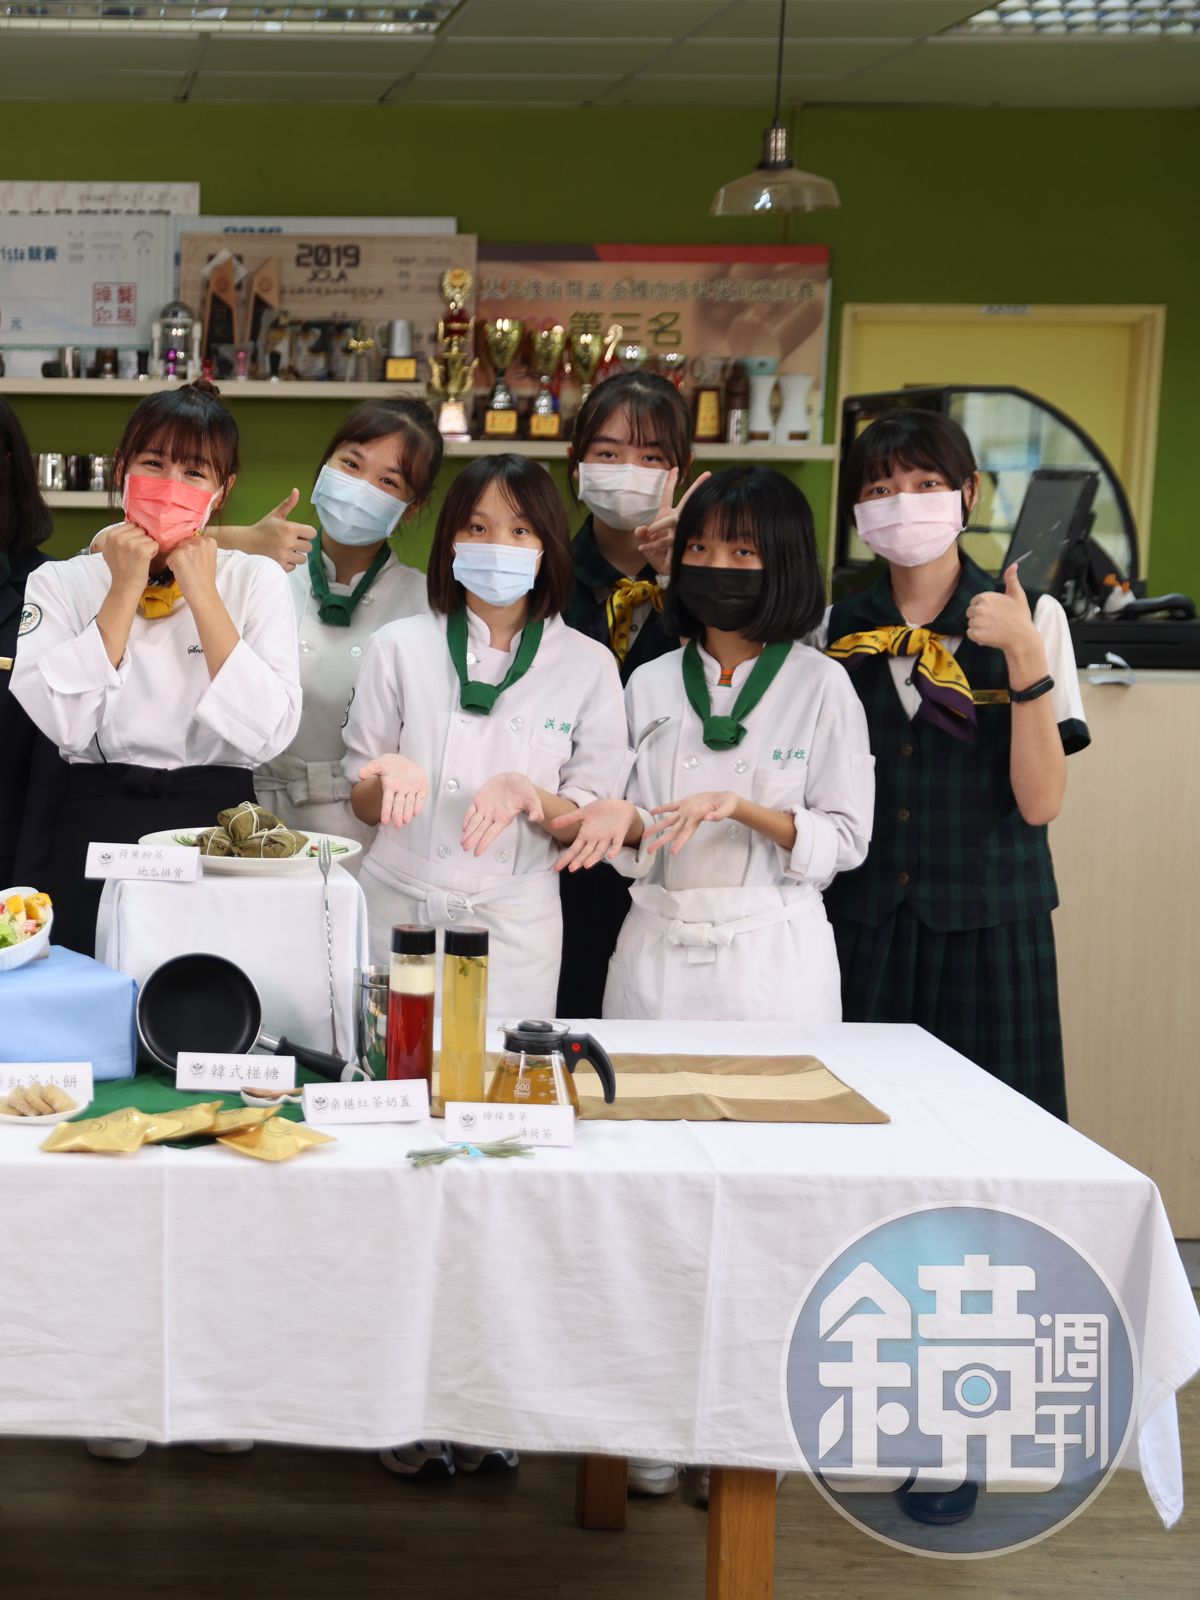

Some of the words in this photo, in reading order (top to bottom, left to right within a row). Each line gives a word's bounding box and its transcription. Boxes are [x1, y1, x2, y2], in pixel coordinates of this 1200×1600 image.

[295, 243, 361, 268] 2019
[9, 316, 23, 331] 元
[567, 309, 684, 347] 第三名
[136, 866, 184, 879] 地瓜排骨
[209, 1063, 281, 1080] 韓式椪糖
[515, 1082, 531, 1092] 600
